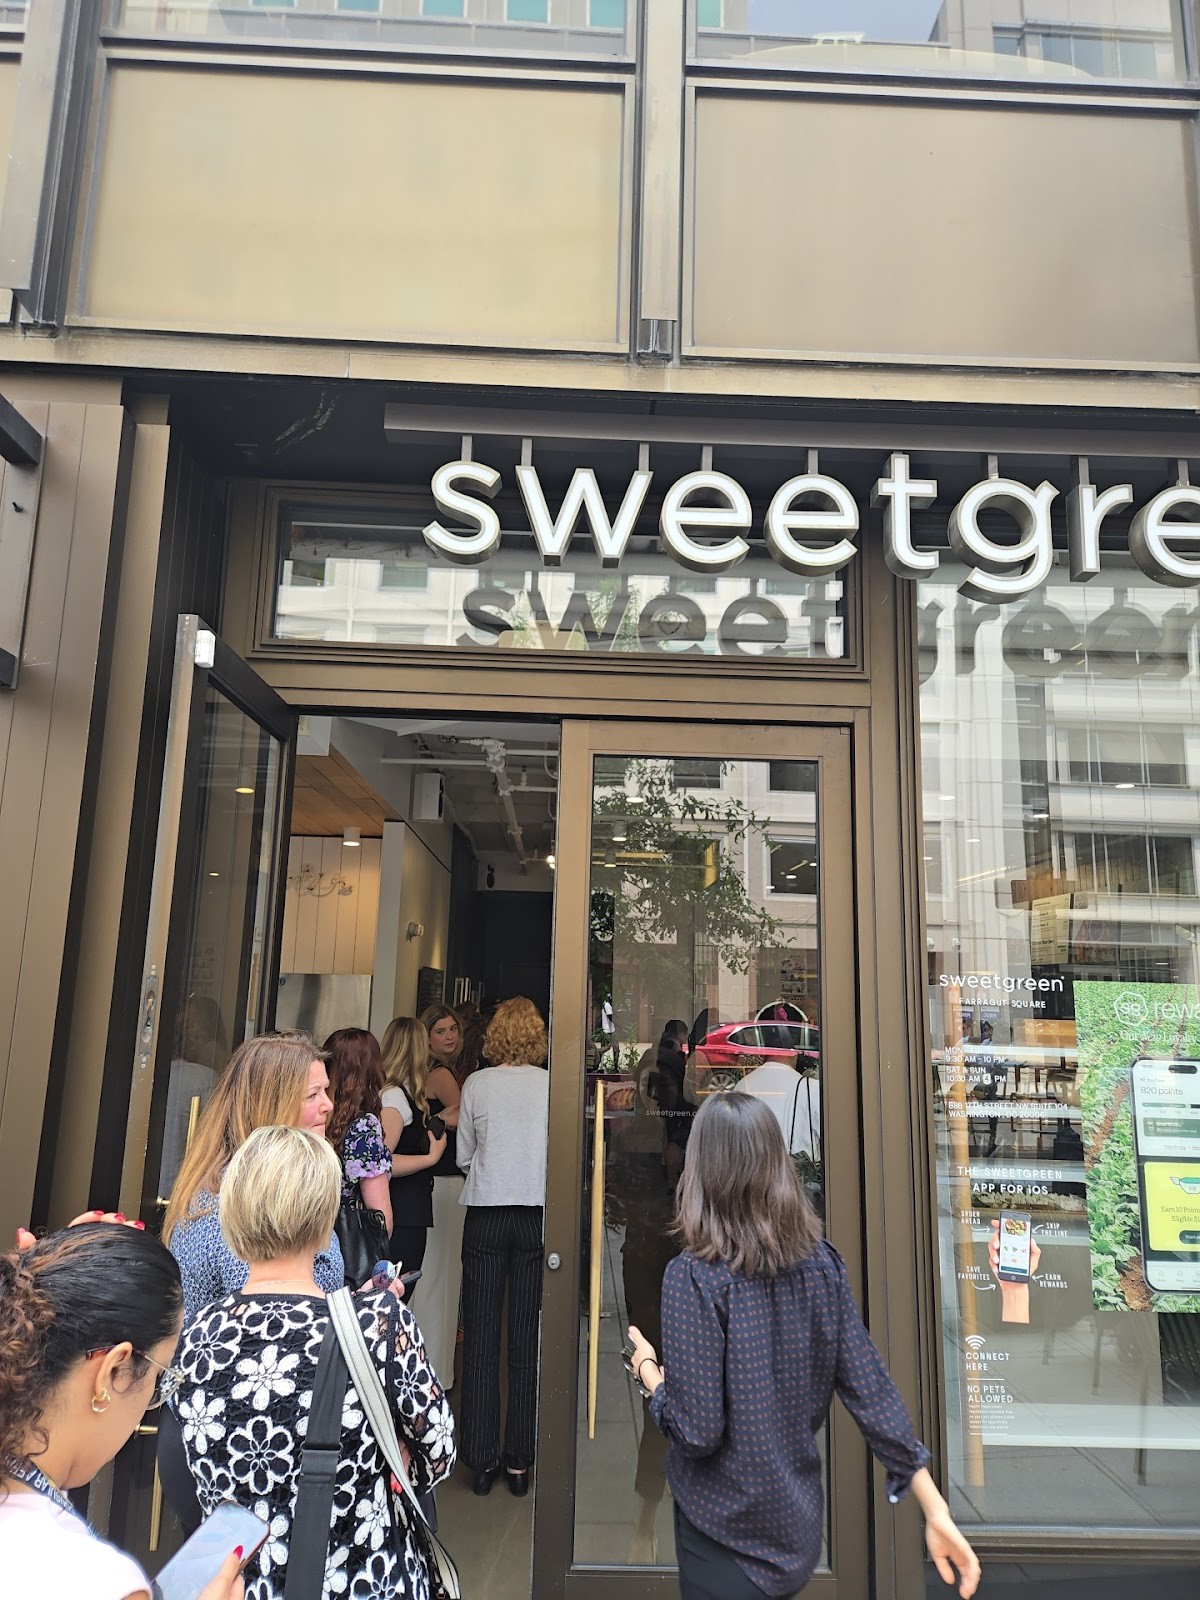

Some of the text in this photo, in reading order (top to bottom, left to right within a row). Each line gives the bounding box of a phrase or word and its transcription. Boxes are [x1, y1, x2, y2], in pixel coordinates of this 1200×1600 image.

[939, 973, 1064, 993] sweetgreen
[958, 998, 1047, 1009] FARRAGUT SQUARE
[945, 1055, 963, 1063] 9:30
[964, 1055, 977, 1063] AM
[982, 1055, 992, 1063] 10
[993, 1055, 1005, 1063] PM
[946, 1066, 961, 1074] SAT
[969, 1066, 987, 1074] SUN
[946, 1075, 966, 1083] 10:30
[968, 1075, 980, 1083] AM
[994, 1075, 1007, 1083] PM
[1141, 1086, 1183, 1096] 820 points
[984, 1102, 1015, 1110] STREET
[1015, 1102, 1029, 1110] NW
[1031, 1102, 1053, 1110] SUITE
[1053, 1103, 1068, 1111] 104
[1006, 1110, 1018, 1118] DC
[957, 1166, 1062, 1179] THE SWEETGREEN
[972, 1183, 1049, 1195] APP FOR iOS
[958, 1273, 990, 1281] FAVORITES
[1045, 1273, 1061, 1281] EARN
[1040, 1281, 1068, 1289] REWARDS
[965, 1352, 1010, 1361] CONNECT
[965, 1363, 988, 1371] HERE
[967, 1385, 1006, 1393] NO PETS
[968, 1394, 1014, 1403] ALLOWED
